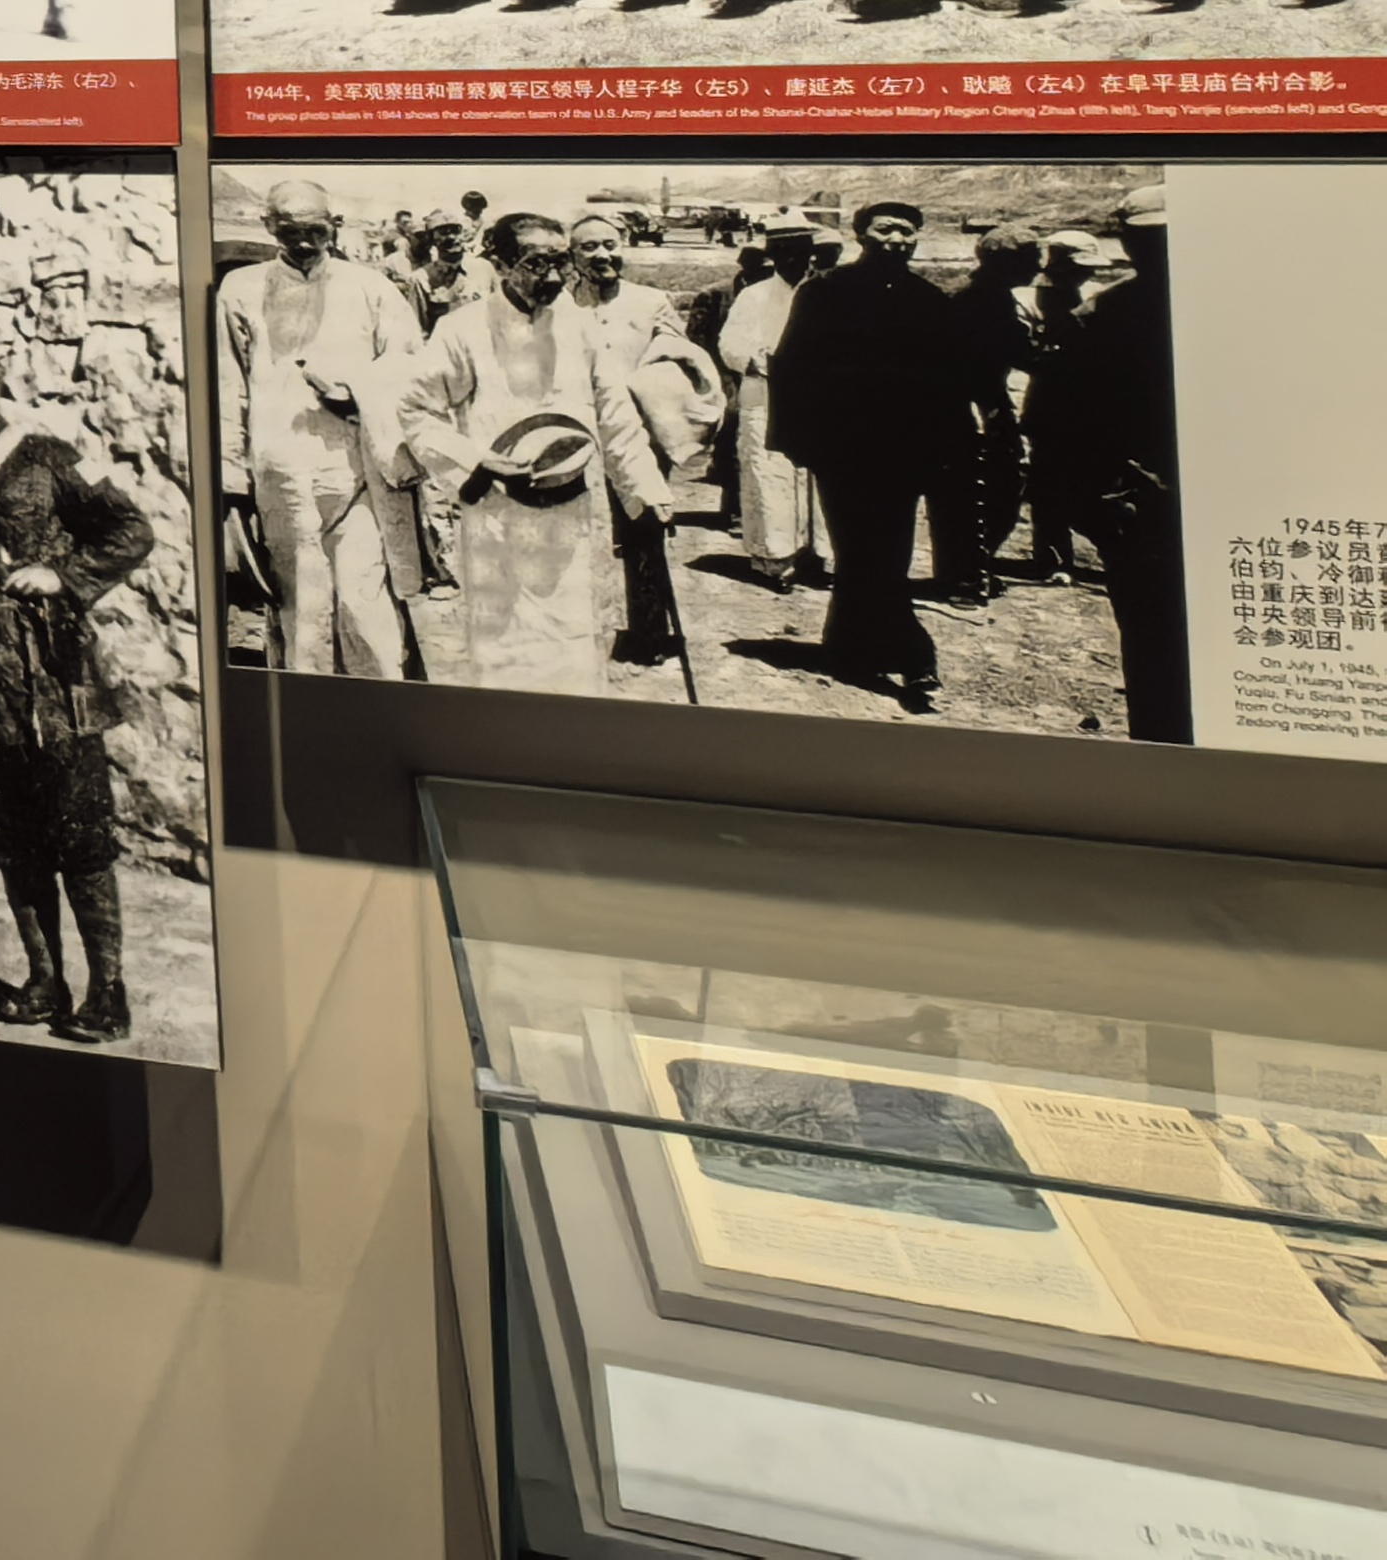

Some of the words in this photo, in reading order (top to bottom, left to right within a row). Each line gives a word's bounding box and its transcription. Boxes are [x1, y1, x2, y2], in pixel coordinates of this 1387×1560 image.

[1234, 625, 1354, 652] 会参观团。
[1260, 657, 1282, 668] On
[1286, 660, 1314, 674] July
[1296, 675, 1343, 690] Huang
[1285, 689, 1304, 700] Fu
[1235, 700, 1268, 712] from
[1236, 715, 1289, 732] Zedong
[1294, 721, 1359, 738] receiving
